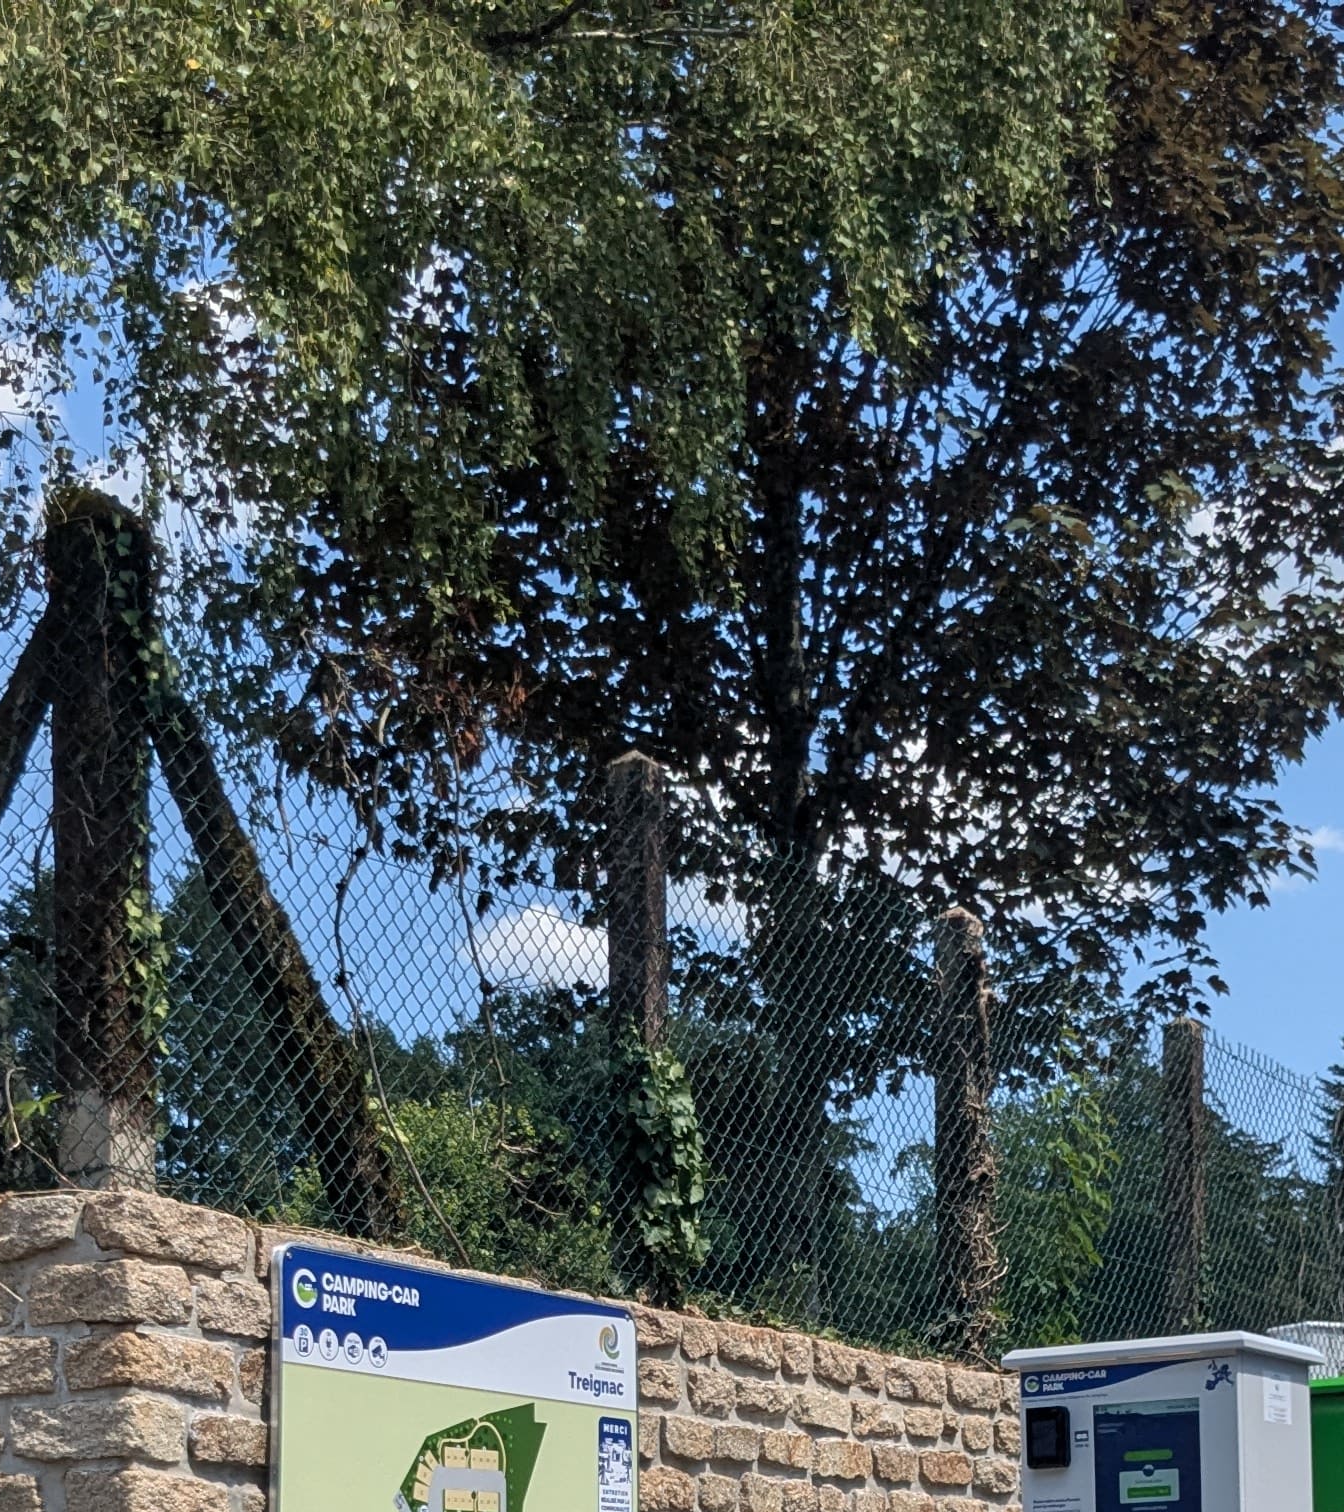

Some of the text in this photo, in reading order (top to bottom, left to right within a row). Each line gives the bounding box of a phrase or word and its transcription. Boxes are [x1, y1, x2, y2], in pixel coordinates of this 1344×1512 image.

[322, 1272, 420, 1307] CAMPING-CAR
[323, 1294, 356, 1316] PARK
[300, 1328, 308, 1336] 30
[1042, 1370, 1107, 1382] CAMPING-CAR
[568, 1371, 624, 1397] Treignac
[1043, 1382, 1064, 1392] PARK
[603, 1423, 628, 1435] MERCI
